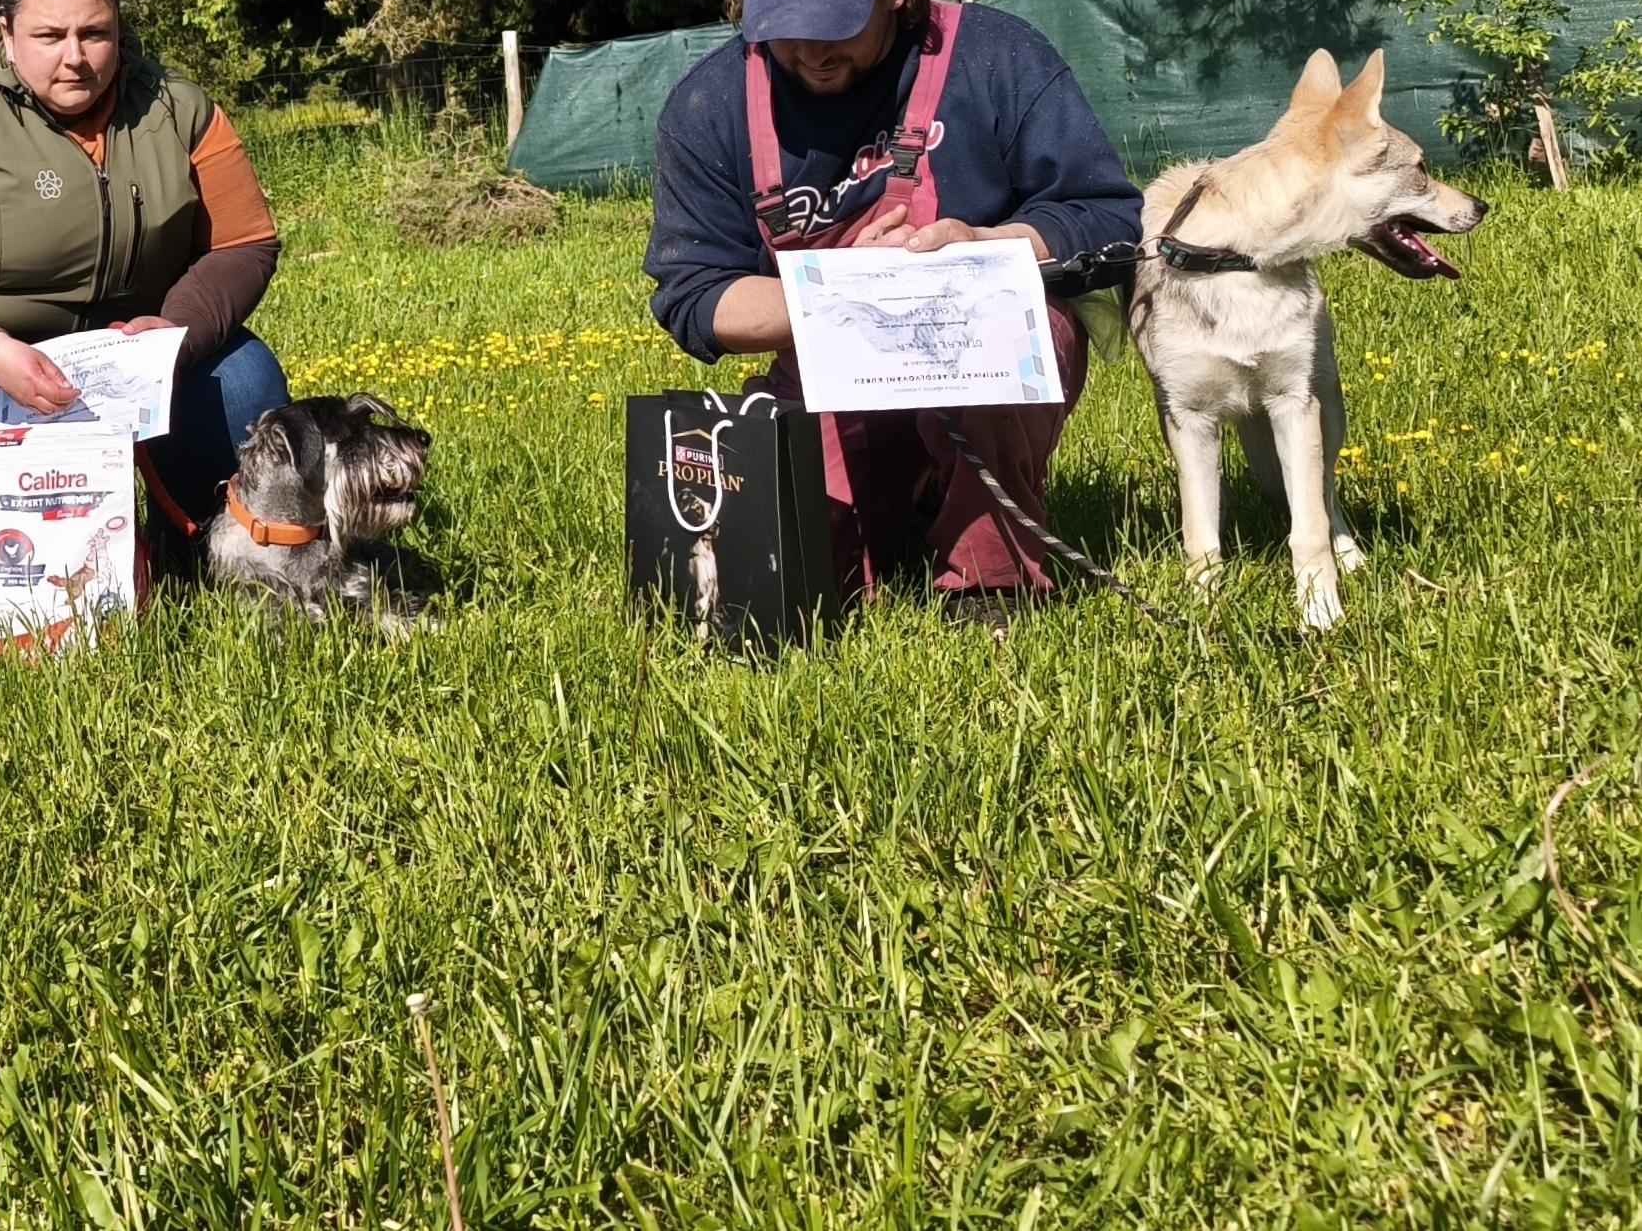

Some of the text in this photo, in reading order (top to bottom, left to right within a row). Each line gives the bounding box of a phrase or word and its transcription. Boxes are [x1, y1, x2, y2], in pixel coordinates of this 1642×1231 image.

[686, 450, 720, 466] PURIN
[18, 468, 88, 492] Calibra
[658, 460, 741, 492] PRO PLAN
[10, 498, 44, 508] EXPERT
